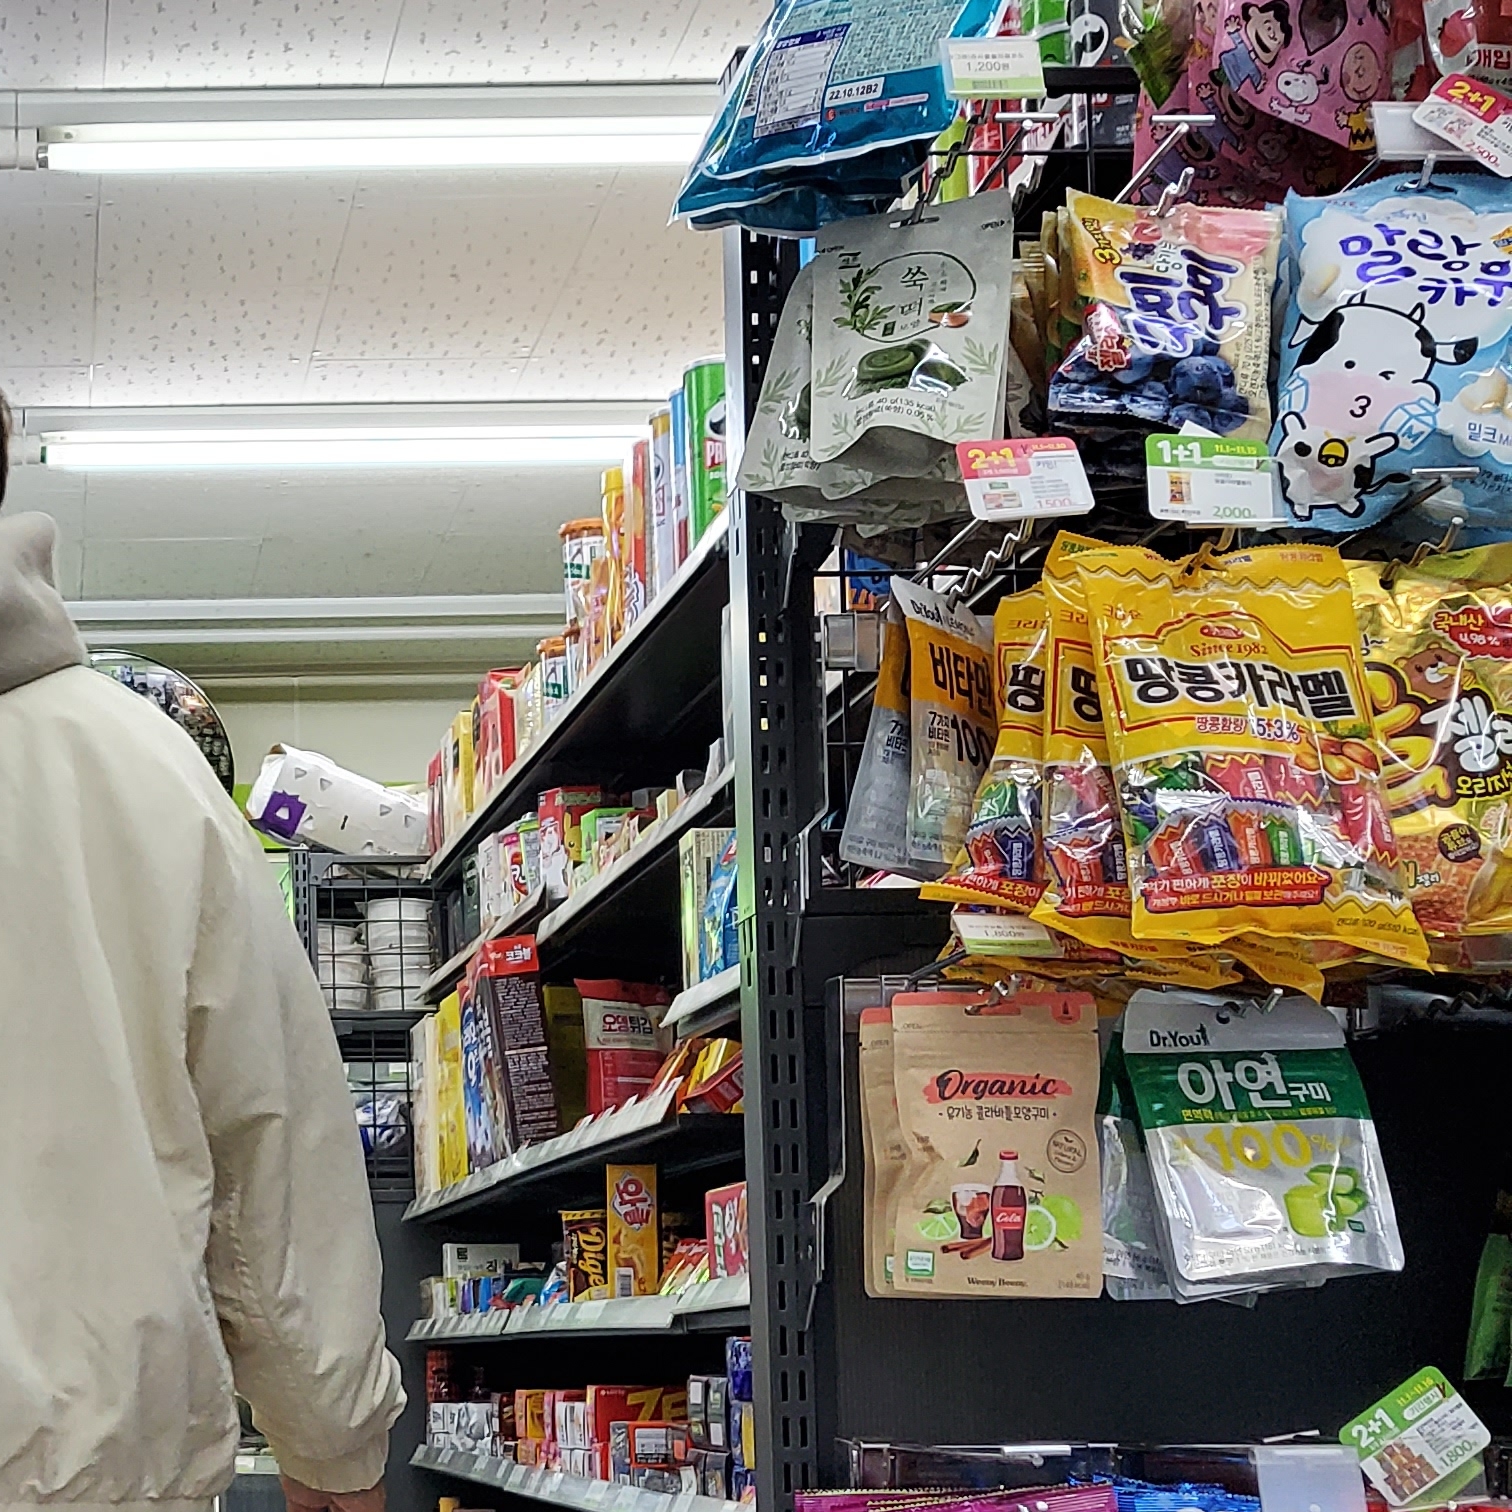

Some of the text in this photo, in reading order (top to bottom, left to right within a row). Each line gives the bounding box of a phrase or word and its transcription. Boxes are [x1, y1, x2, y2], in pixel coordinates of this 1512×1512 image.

[965, 61, 1010, 72] 1,200원
[1447, 80, 1497, 114] 2+1
[1339, 223, 1482, 285] 말랑
[900, 265, 929, 292] 쑥
[1467, 421, 1498, 444] 밀크
[967, 448, 1017, 470] 2+1
[1156, 439, 1202, 465] 1+1
[1190, 641, 1269, 658] Since 1982
[1125, 657, 1357, 720] 땅콩카라멜
[1195, 716, 1247, 734] 땅콩함량
[1171, 876, 1210, 893] 편하게
[1212, 873, 1253, 889] 포장이
[1202, 890, 1244, 904] 드시거나
[1149, 1028, 1204, 1048] Dr.You
[936, 1069, 1059, 1101] Organic
[1177, 1051, 1332, 1110] 아연 구미
[946, 1106, 974, 1120] 유기농
[995, 1211, 1022, 1224] Cola
[1351, 1407, 1396, 1449] 2+1
